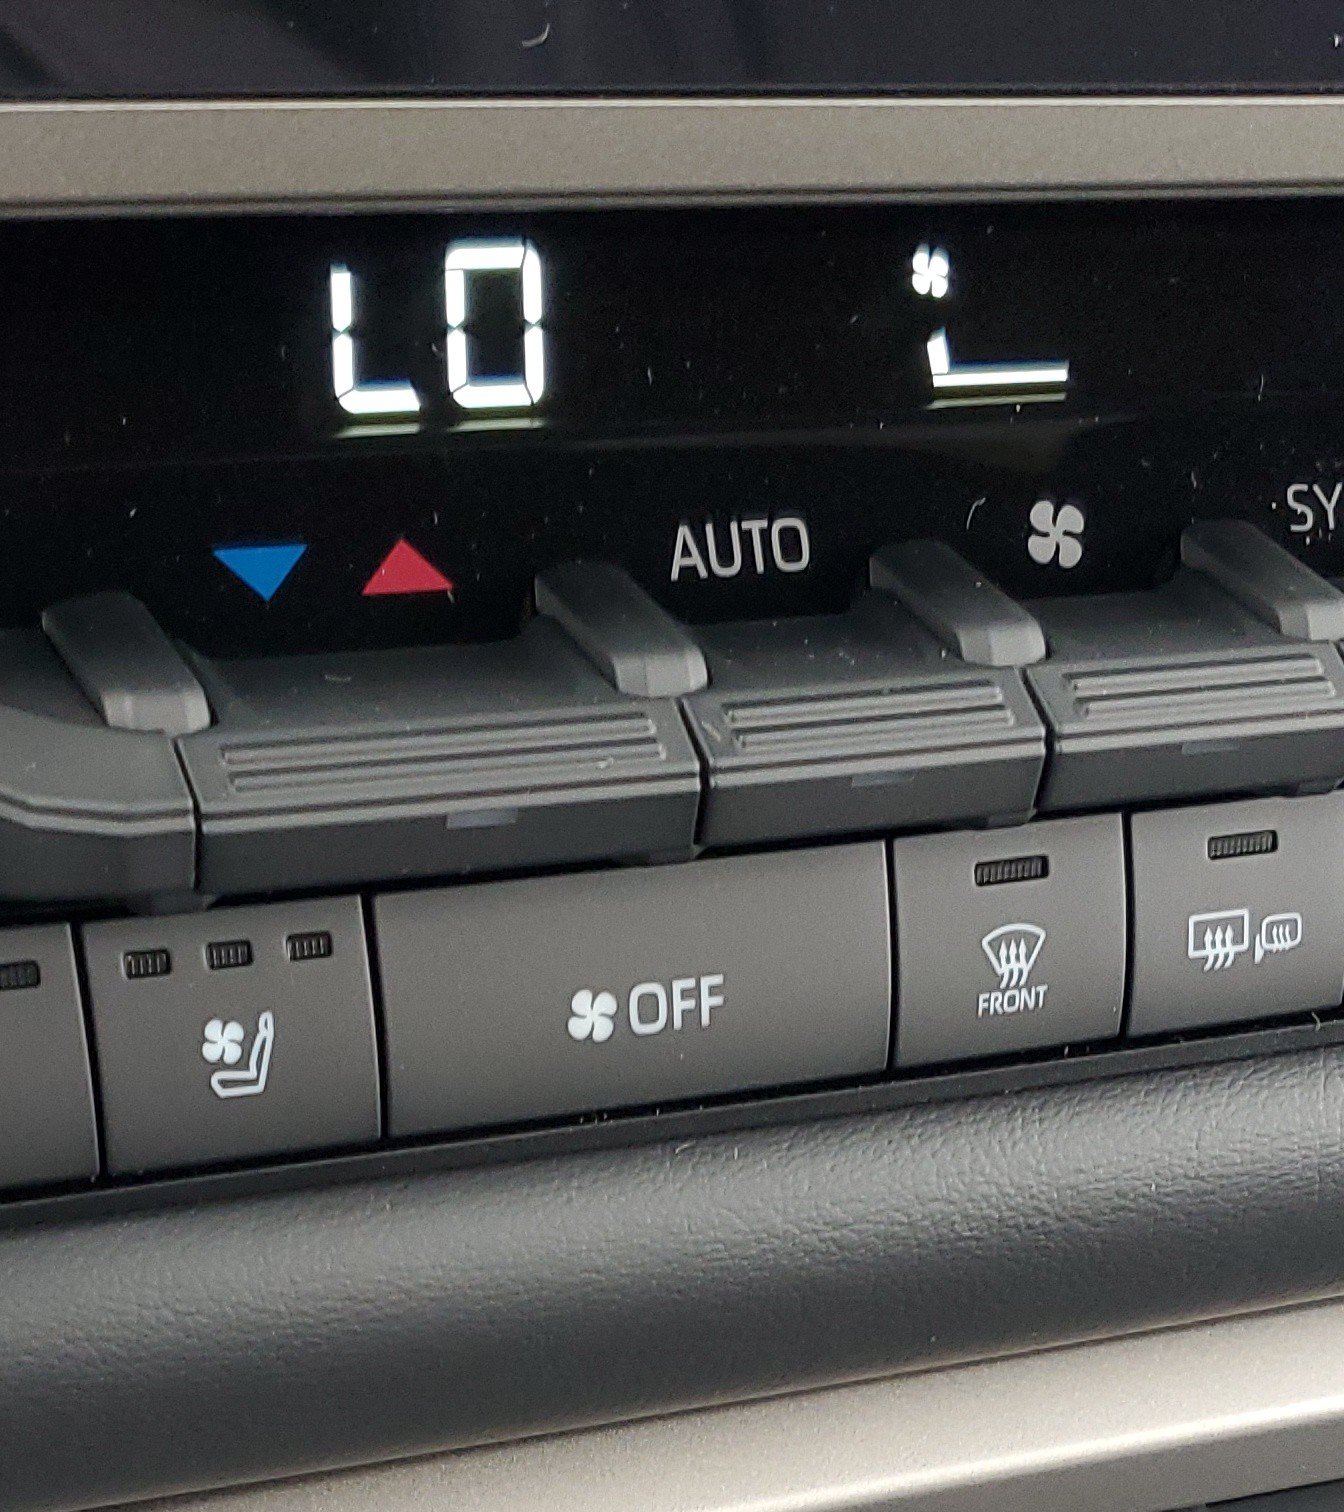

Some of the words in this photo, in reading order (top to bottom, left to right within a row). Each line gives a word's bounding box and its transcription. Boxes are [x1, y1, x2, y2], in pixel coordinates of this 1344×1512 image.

[670, 516, 811, 582] AUTO
[628, 973, 725, 1036] OFF
[977, 984, 1049, 1018] FRONT
